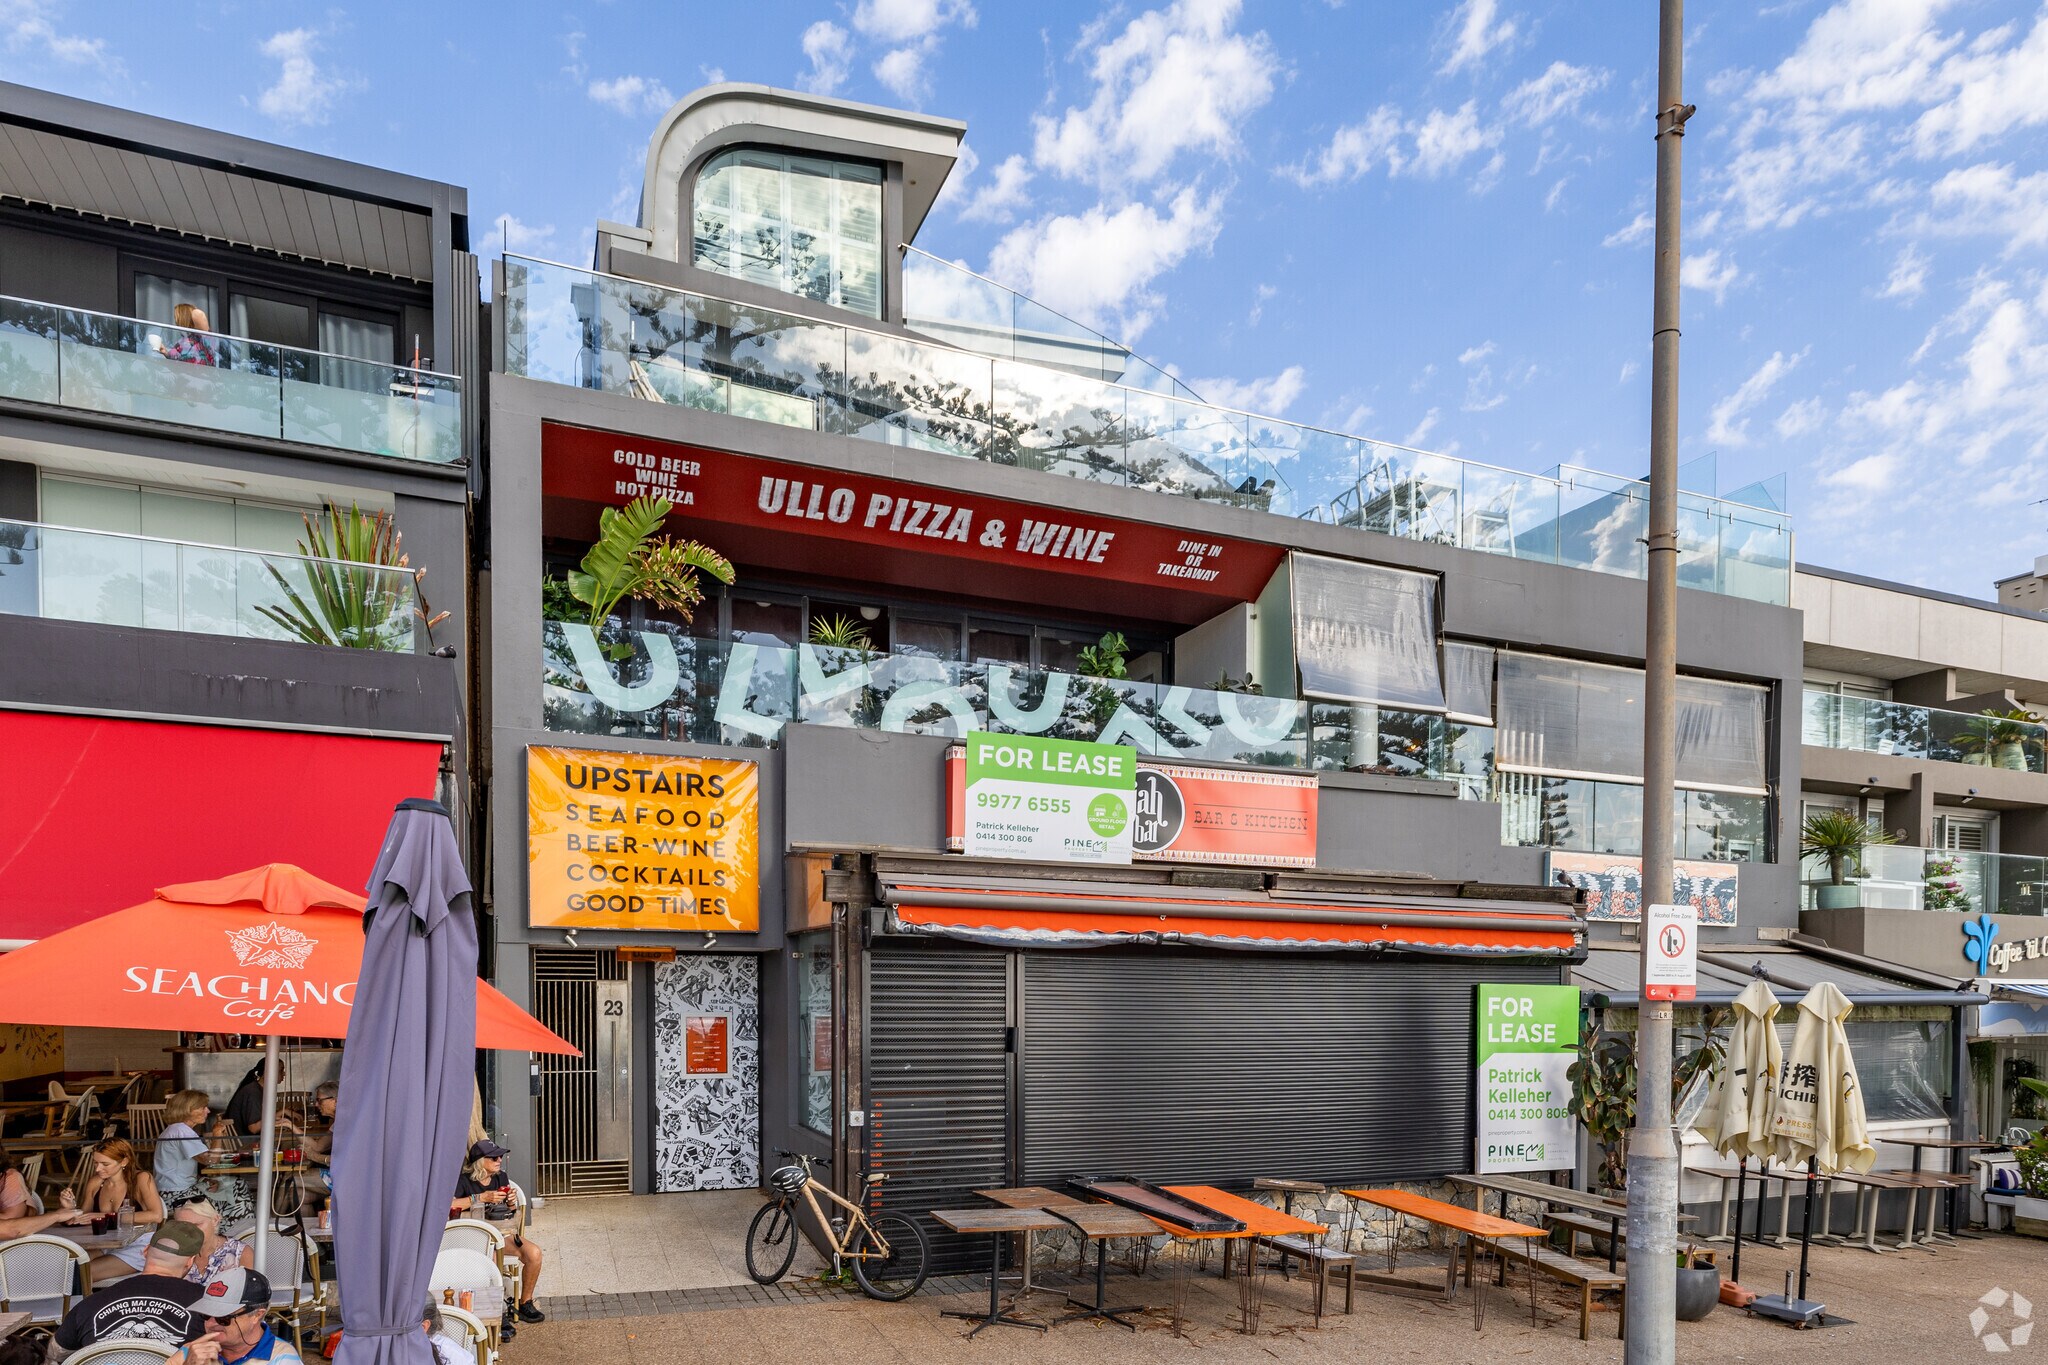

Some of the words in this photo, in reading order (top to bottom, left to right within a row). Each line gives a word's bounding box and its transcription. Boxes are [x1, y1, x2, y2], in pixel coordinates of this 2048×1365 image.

[614, 449, 656, 469] COLD
[661, 457, 700, 476] BEER
[635, 468, 678, 488] WINE
[615, 480, 647, 498] HOT
[652, 486, 694, 505] PIZZA
[758, 476, 855, 523] ULLO
[864, 493, 973, 542] PIZZA
[979, 519, 1006, 548] &
[1016, 520, 1115, 563] WINE
[1177, 540, 1208, 555] DINE
[1207, 545, 1223, 557] IN
[1185, 555, 1203, 567] OR
[1157, 563, 1220, 581] TAKEAWAY
[978, 744, 1033, 770] FOR
[1042, 751, 1122, 777] LEASE
[565, 765, 725, 798] UPSTAIRS
[977, 792, 1022, 810] 9977
[1028, 797, 1071, 814] 6555
[566, 803, 725, 829] SEAFOOD
[1194, 810, 1223, 825] BAR
[1244, 814, 1308, 830] KITCHEN
[976, 821, 1004, 831] Patrick
[1006, 824, 1040, 833] Kelleher
[567, 834, 726, 858] BEER-WINE
[976, 832, 996, 841] 0414
[998, 833, 1015, 842] 300
[1016, 834, 1033, 843] 806
[1064, 838, 1092, 847] PINE
[566, 863, 726, 887] COCKTAILS
[566, 894, 644, 912] GOOD
[656, 896, 726, 915] TIMES
[1988, 942, 2022, 973] Coffee
[223, 1001, 295, 1026] Café
[603, 1000, 623, 1016] 23
[1488, 997, 1533, 1017] FOR
[1488, 1023, 1556, 1043] LEASE
[1489, 1068, 1542, 1083] Patrick
[1489, 1089, 1552, 1103] Kelleher
[1780, 1089, 1818, 1104] ICHIB
[1488, 1108, 1516, 1120] 0414
[1520, 1108, 1543, 1120] 300
[1546, 1107, 1568, 1119] 806
[1786, 1119, 1812, 1129] PRESS
[1488, 1144, 1525, 1157] PINE
[98, 1301, 129, 1320] CHIANG
[149, 1300, 186, 1319] CHAPTER
[119, 1308, 164, 1316] THAILAND
